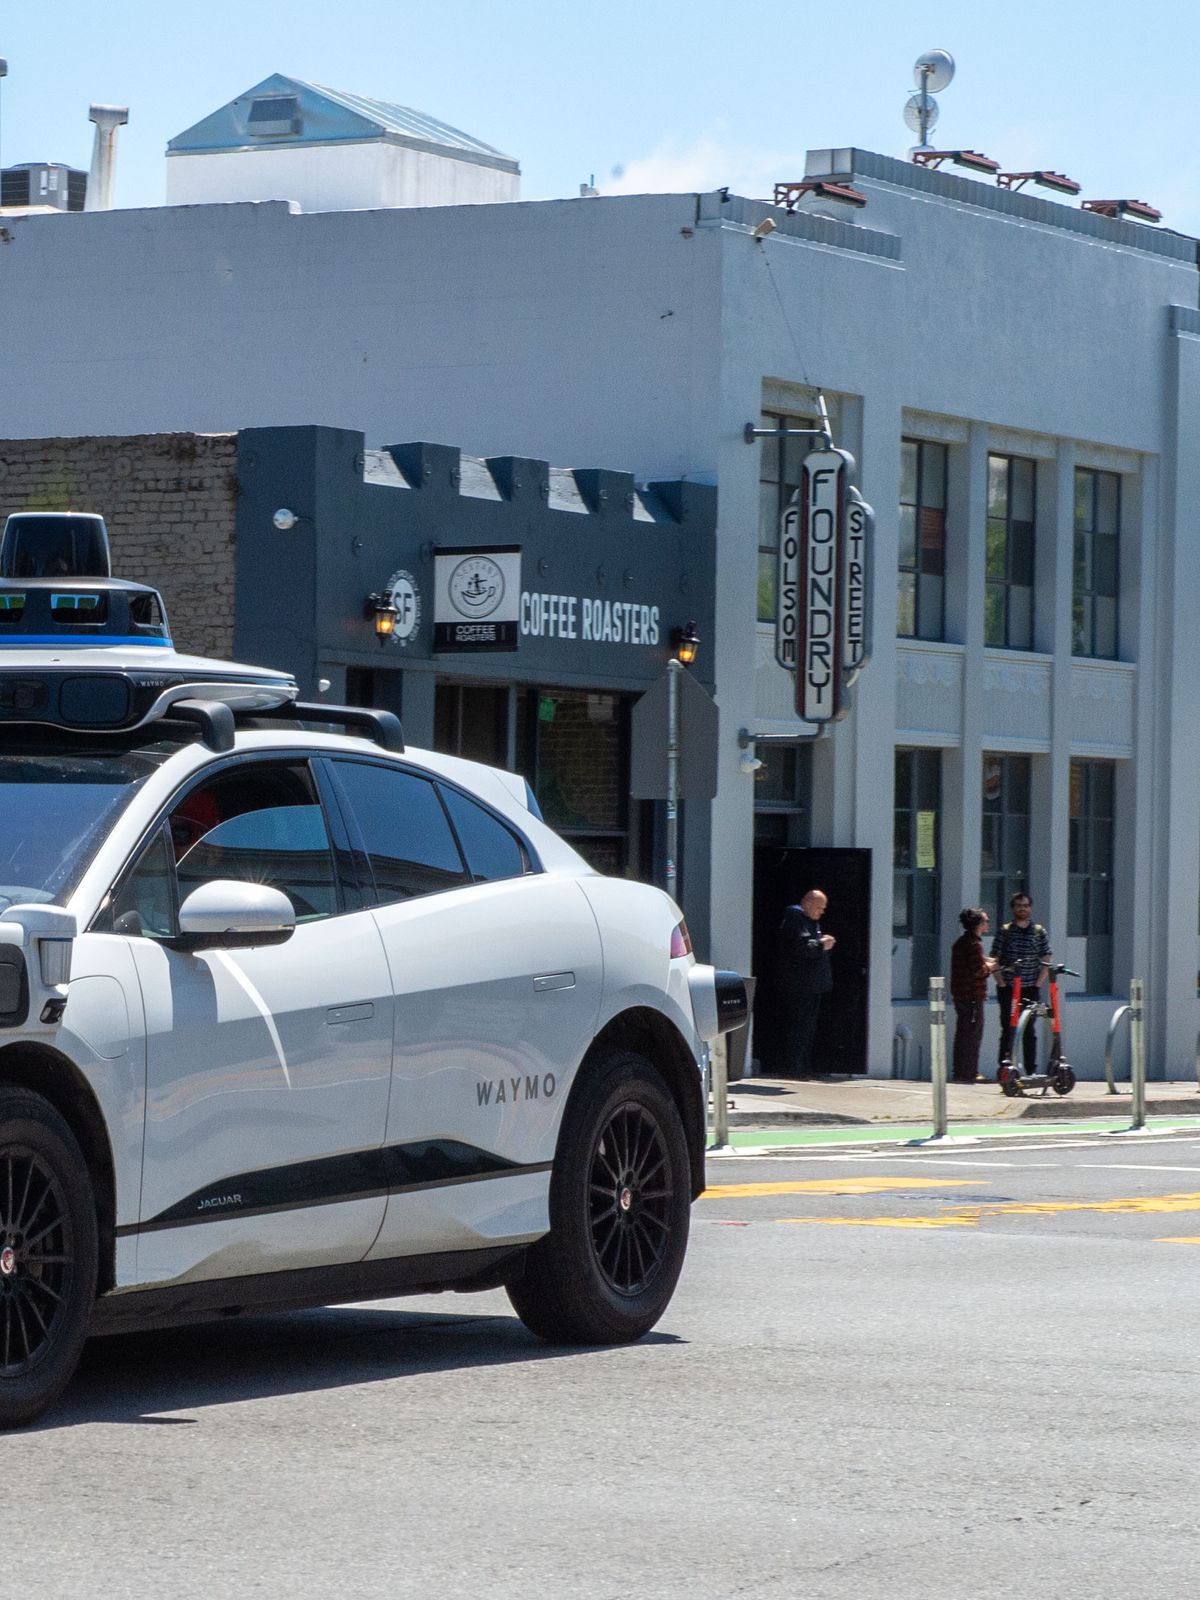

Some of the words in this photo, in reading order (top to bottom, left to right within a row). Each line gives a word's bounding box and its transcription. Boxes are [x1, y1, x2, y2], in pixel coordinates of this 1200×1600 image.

[782, 510, 798, 662] FOLSOM
[809, 469, 835, 704] FOUNDRY
[847, 510, 863, 663] STREET
[394, 592, 413, 625] SF
[455, 624, 496, 635] COFFEE
[520, 591, 577, 639] COFFEE
[581, 598, 660, 645] ROASTERS
[476, 1073, 556, 1107] WAYMO
[197, 1194, 242, 1210] JAGUAR
